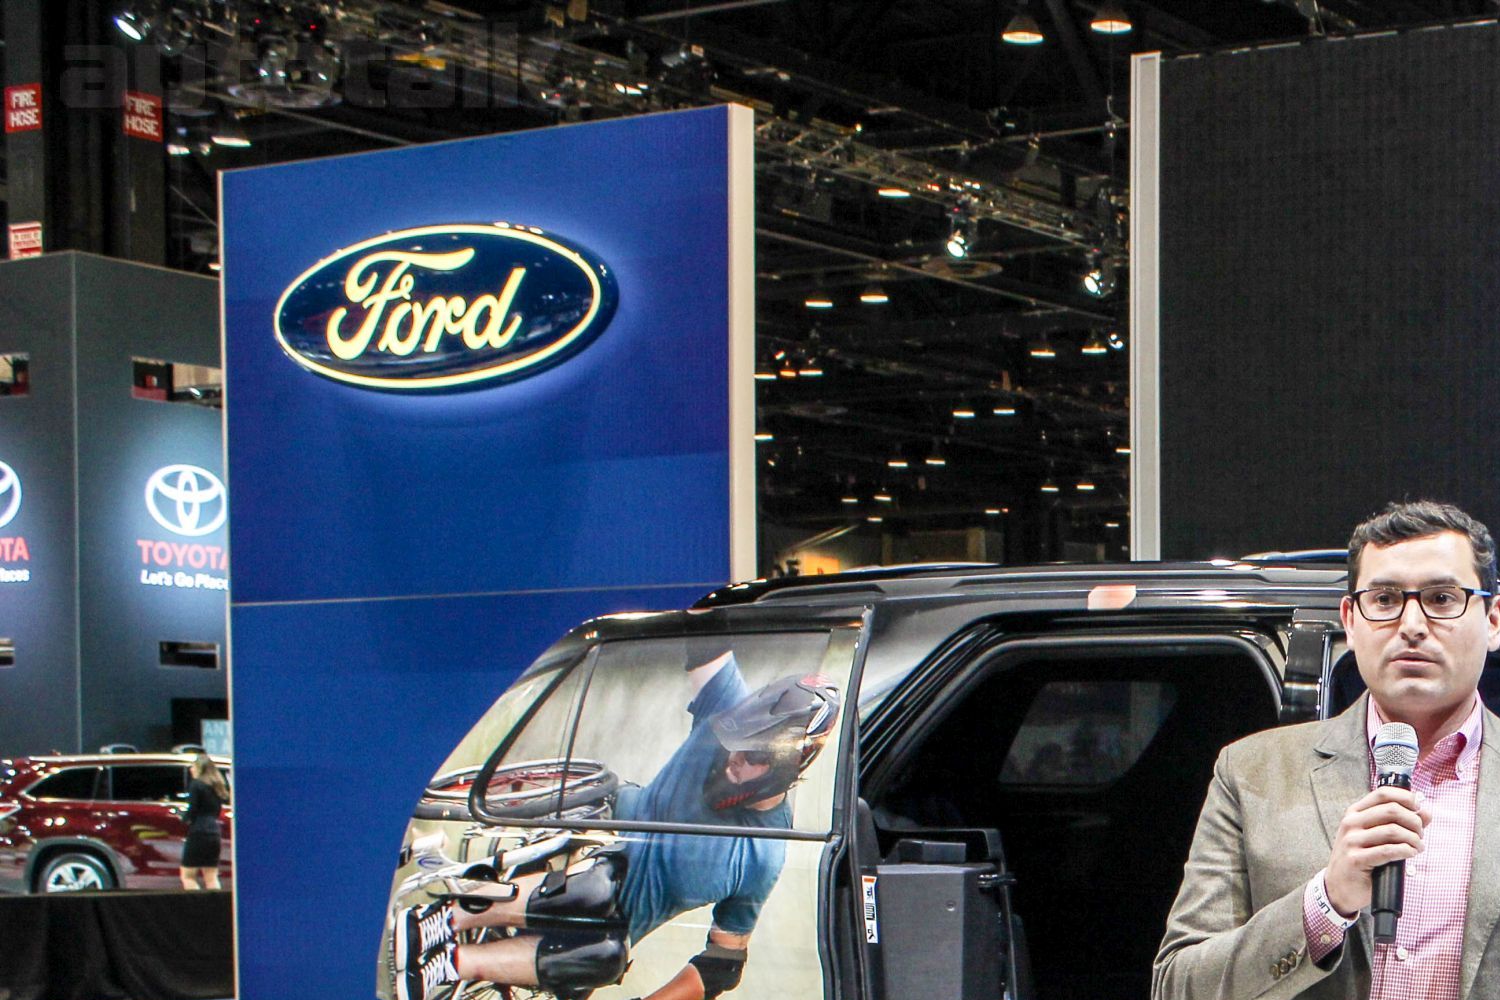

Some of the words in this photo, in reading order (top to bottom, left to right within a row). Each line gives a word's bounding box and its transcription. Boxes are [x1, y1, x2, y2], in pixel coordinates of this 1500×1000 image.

[11, 90, 37, 109] FIRE
[126, 96, 157, 118] FIRE
[10, 109, 39, 127] HOSE
[125, 115, 159, 136] HOSE
[326, 247, 527, 360] Ford
[140, 569, 173, 587] Let's
[174, 571, 195, 588] Go
